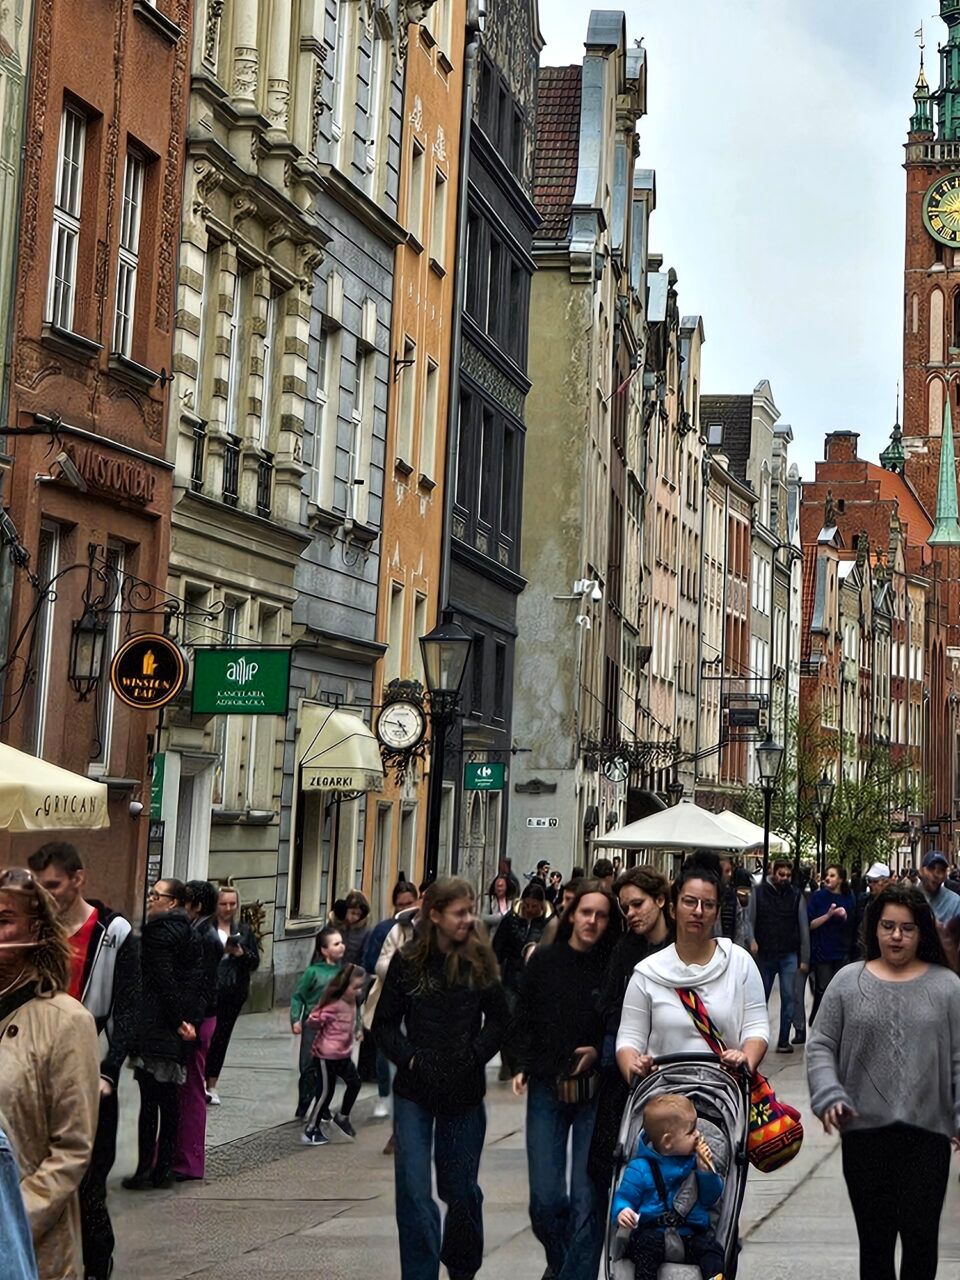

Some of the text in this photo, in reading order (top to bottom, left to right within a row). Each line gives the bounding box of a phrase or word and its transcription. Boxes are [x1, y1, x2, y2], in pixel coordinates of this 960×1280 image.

[122, 677, 170, 689] WINSTON
[134, 688, 156, 698] BAR
[310, 777, 353, 786] ZEGARKI
[35, 795, 97, 816] GRYCAN
